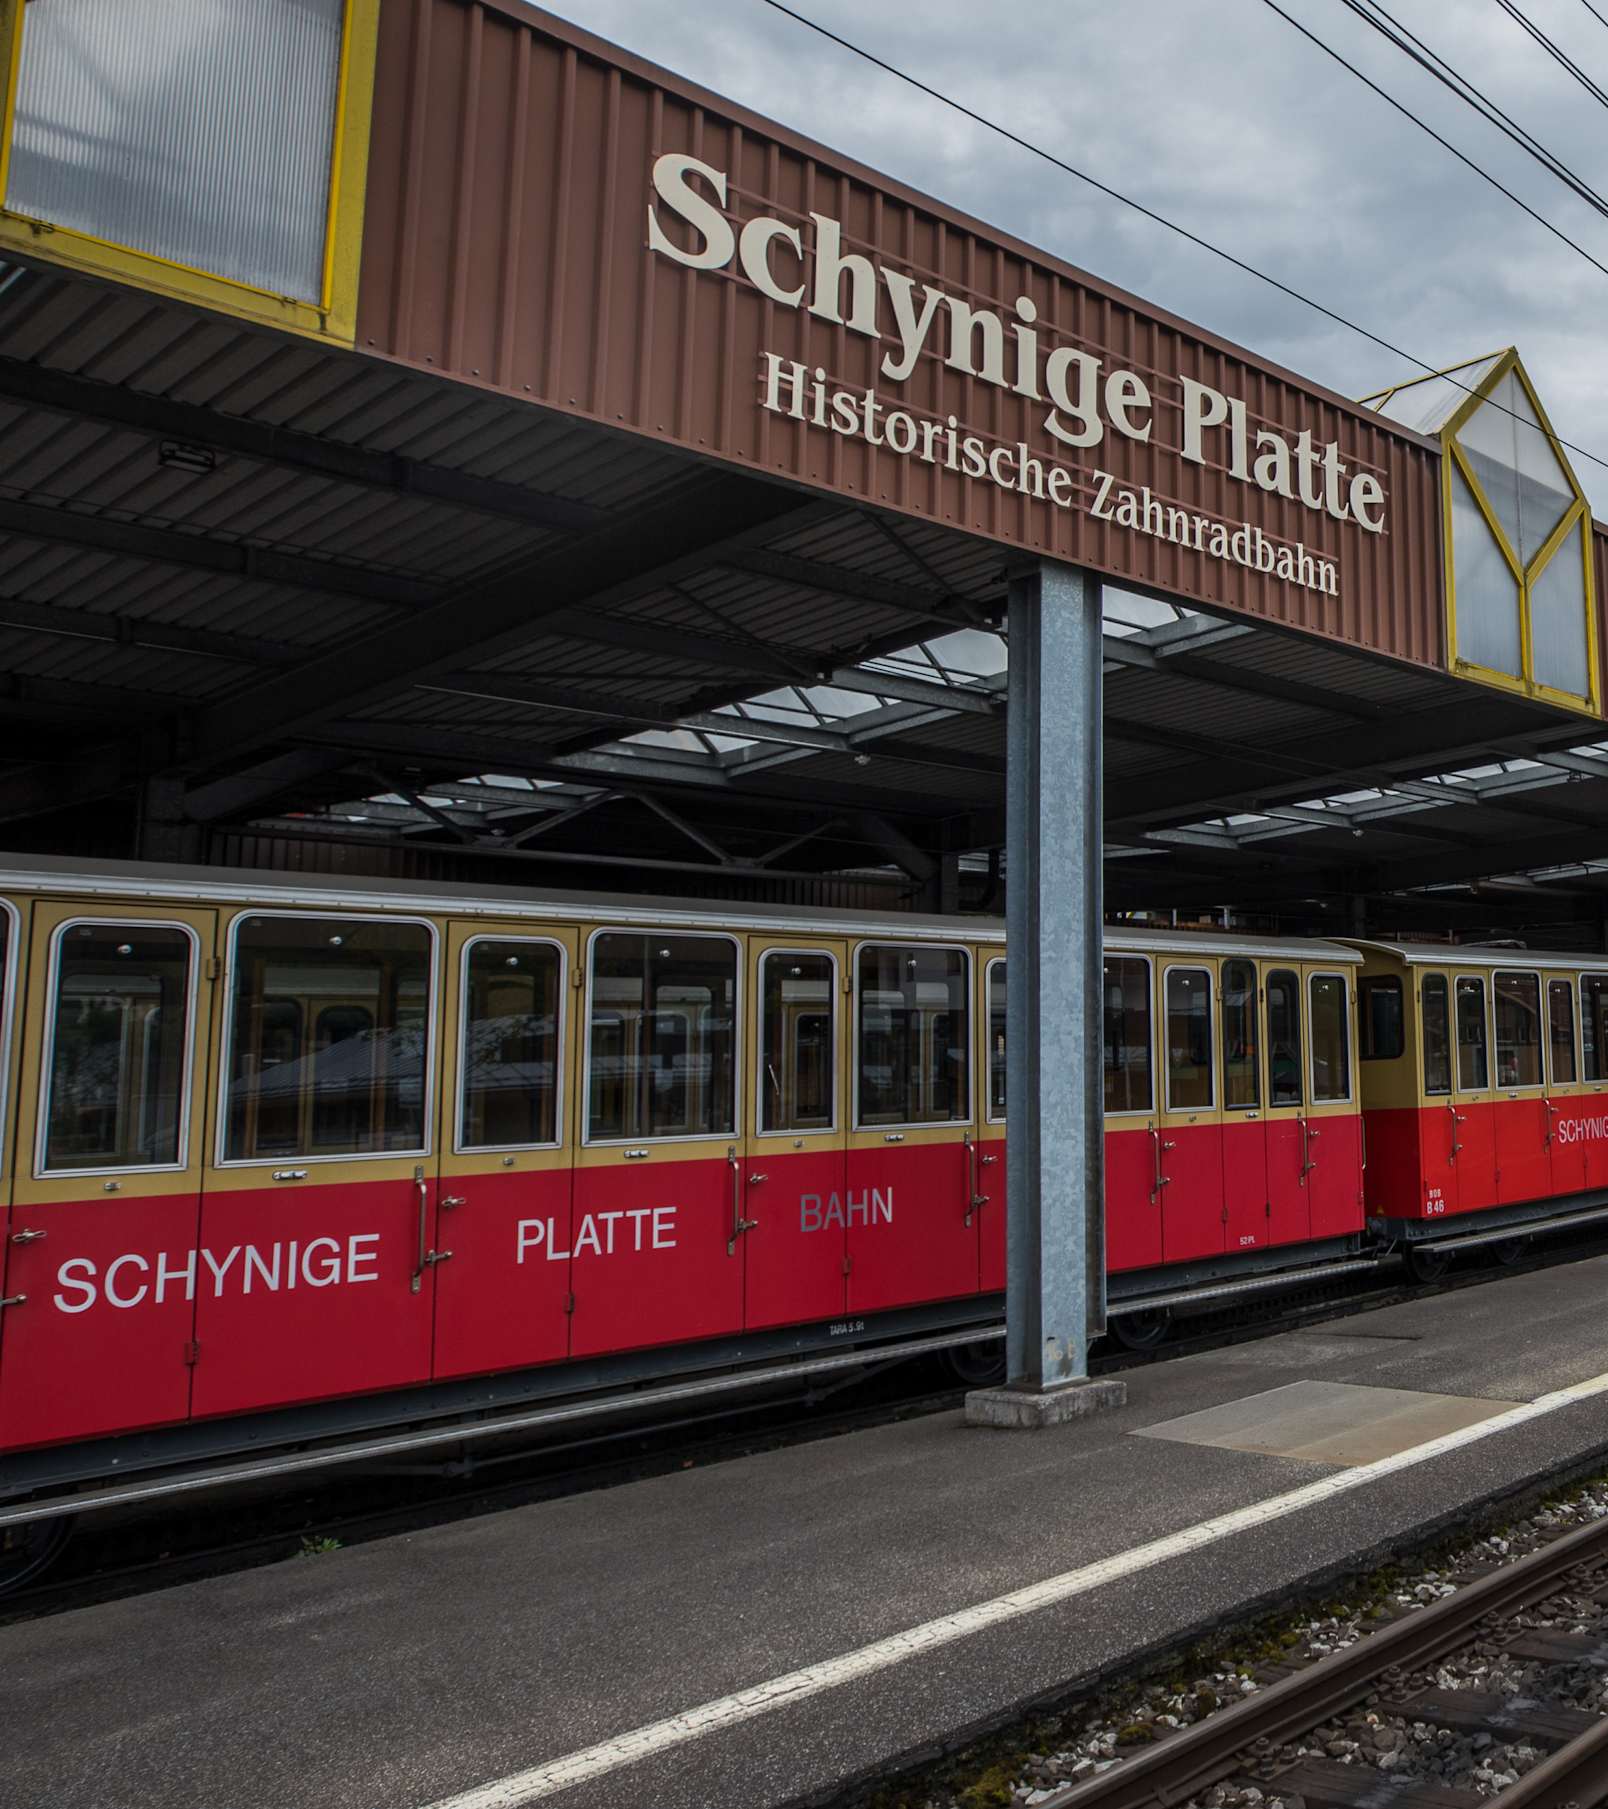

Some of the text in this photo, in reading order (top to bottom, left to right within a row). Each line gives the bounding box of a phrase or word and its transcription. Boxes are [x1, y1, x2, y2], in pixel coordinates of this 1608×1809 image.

[647, 152, 1386, 534] Schynige Platte
[762, 351, 1340, 597] Historische Zahnradbahn
[53, 1186, 894, 1314] SCHYNIGE PLATTE BAHN
[1434, 1199, 1445, 1213] 46
